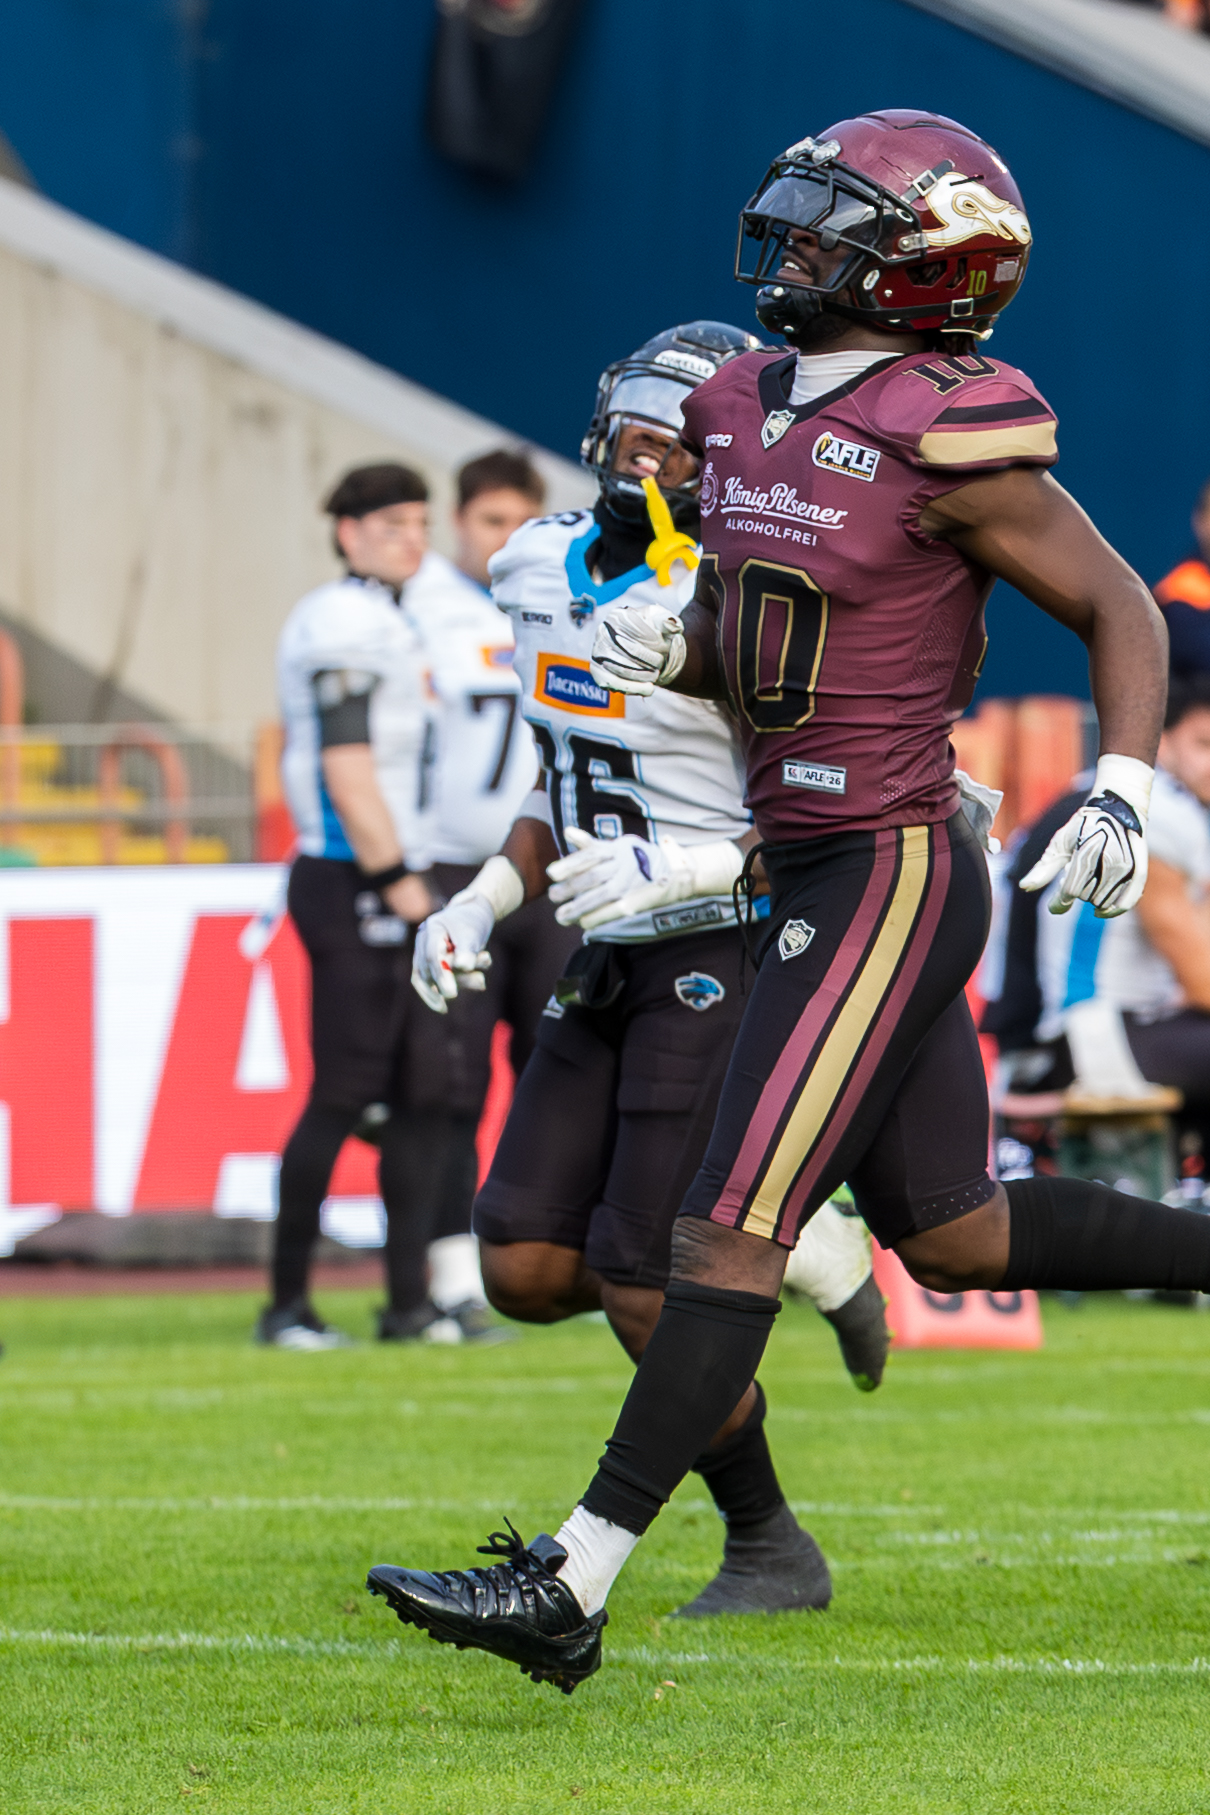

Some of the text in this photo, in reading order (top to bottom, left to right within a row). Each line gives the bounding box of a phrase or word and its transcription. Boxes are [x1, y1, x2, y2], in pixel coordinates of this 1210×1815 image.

[967, 270, 987, 295] 10
[820, 441, 877, 473] AFLE
[725, 518, 818, 547] ALKOHOLFREI
[804, 770, 824, 782] AFLE
